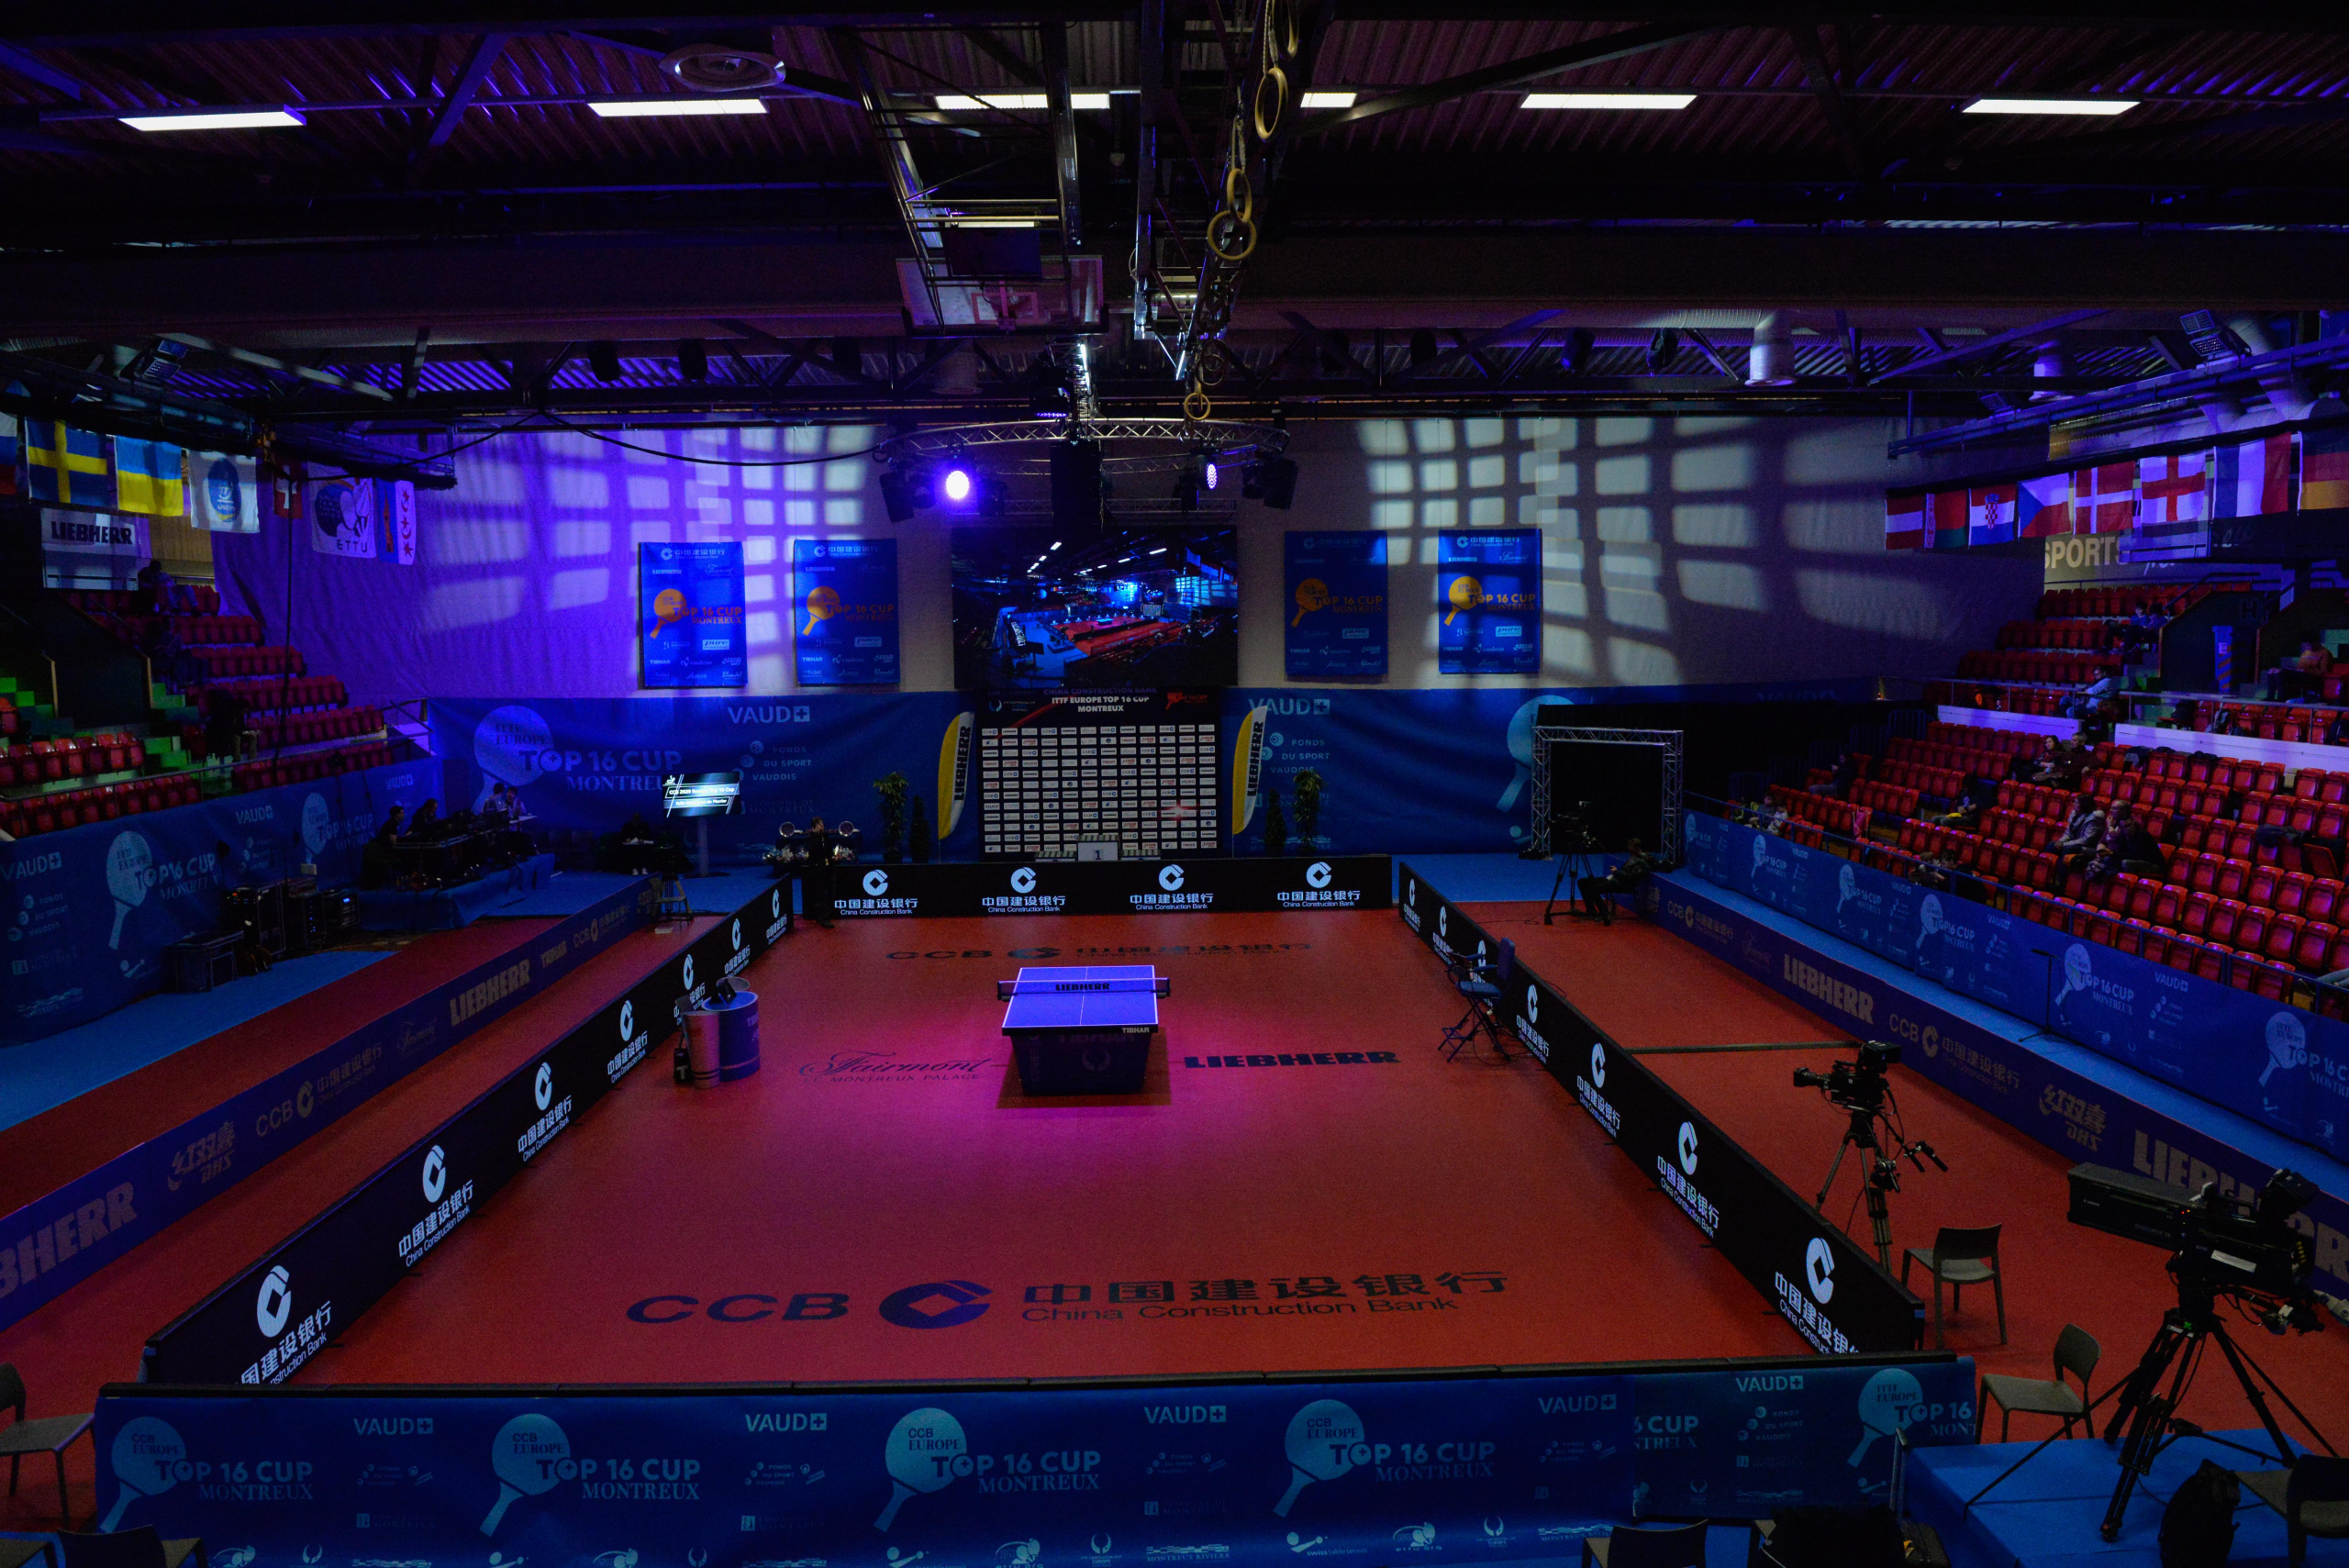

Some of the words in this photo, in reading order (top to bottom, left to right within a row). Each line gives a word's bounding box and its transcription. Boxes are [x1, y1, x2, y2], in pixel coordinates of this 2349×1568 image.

[50, 520, 133, 545] LIEBHERR
[337, 539, 368, 553] ETTU
[870, 604, 895, 614] CUP
[1357, 595, 1383, 606] CUP
[1467, 595, 1493, 605] TOP
[1497, 595, 1508, 604] 16
[1511, 594, 1536, 604] CUP
[1486, 603, 1535, 612] MONTREUX
[673, 607, 698, 617] TOP
[702, 607, 714, 617] 16
[717, 606, 742, 617] CUP
[1332, 606, 1382, 614] MONTREUX
[728, 706, 791, 723] VAUD
[1248, 697, 1311, 716] VAUD
[495, 734, 549, 745] EUROPE
[518, 749, 583, 772] TOP
[588, 751, 618, 772] 16
[622, 750, 683, 772] CUP
[781, 759, 812, 767] SPORT
[954, 726, 972, 800] LIEBHERR
[1247, 721, 1264, 796] LIEBHERR
[752, 773, 796, 781] VAUDOIS
[236, 806, 267, 825] VAUD
[1094, 850, 1101, 861] 1
[0, 855, 49, 881] VAUD
[135, 863, 169, 891] TOP
[170, 861, 184, 882] 16
[186, 852, 217, 877] CUP
[834, 898, 918, 910] 中国建设银行
[982, 895, 1066, 907] 中国建设银行
[1130, 893, 1214, 905] 中国建设银行
[1277, 890, 1361, 902] 中国建设银行
[1868, 892, 1882, 906] CUP
[1667, 900, 1684, 919] CCB
[1956, 925, 1976, 941] CUP
[724, 944, 751, 974] 中国建设银行
[885, 950, 993, 960] CCB
[1055, 983, 1110, 991] LIEBHERR
[1783, 952, 1874, 1025] LIEBHERR
[2080, 971, 2100, 988] TOP
[2100, 979, 2111, 995] 16
[2111, 984, 2134, 1002] CUP
[2154, 971, 2180, 989] VAUD
[449, 959, 530, 1028] LIEBHERR
[2092, 991, 2133, 1016] MONTREUX
[1516, 1014, 1550, 1058] 中国建设银行
[1889, 1013, 1920, 1043] CCB
[607, 1030, 648, 1075] 中国建设银行
[1184, 1051, 1402, 1068] LIEBHERR
[2288, 1044, 2321, 1068] TOP
[2323, 1057, 2335, 1076] 16
[799, 1051, 991, 1076] Fairmont
[1943, 1036, 2021, 1090] 中国建设银行
[1576, 1074, 1620, 1130] 中国建设银行
[2042, 1083, 2108, 1135] 红双喜
[256, 1099, 294, 1138] CCB
[518, 1095, 572, 1153] 中国建设银行
[523, 1146, 536, 1162] China
[536, 1126, 560, 1151] Construction
[559, 1117, 570, 1130] Bank
[2065, 1119, 2103, 1152] DHS
[171, 1120, 236, 1175] 红双喜
[200, 1150, 235, 1184] DHS
[1657, 1155, 1720, 1230] 中国建设银行
[1661, 1177, 1674, 1195] China
[1674, 1190, 1701, 1228] Construction
[1701, 1218, 1714, 1239] Bank
[398, 1179, 473, 1258] 中国建设银行
[406, 1247, 423, 1267] China
[424, 1216, 457, 1251] Construction
[456, 1205, 471, 1223] Bank
[1024, 1271, 1509, 1305] 中国建设银行
[626, 1293, 850, 1323] CCB
[1022, 1307, 1123, 1323] China
[1139, 1299, 1356, 1320] Construction
[1367, 1296, 1458, 1312] Bank
[1775, 1271, 1859, 1354] 中国建设银
[1780, 1299, 1798, 1325] China
[236, 1300, 332, 1384] 国建设银行
[306, 1332, 328, 1357] Bank
[1735, 1376, 1788, 1392] VAUD
[1539, 1395, 1598, 1415] VAUD
[1876, 1392, 1917, 1403] EUROPE
[1144, 1405, 1208, 1425] VAUD
[1894, 1403, 1944, 1423] TOP
[1949, 1401, 1972, 1420] 16
[353, 1418, 414, 1436] VAUD
[745, 1413, 807, 1432] VAUD
[1307, 1418, 1332, 1429] CCB
[1647, 1415, 1698, 1434] CUP
[1779, 1420, 1803, 1429] SPORT
[512, 1432, 538, 1442] CCB
[908, 1428, 934, 1439] CCB
[1307, 1428, 1358, 1440] EUROPE
[1755, 1432, 1791, 1440] VAUDOIS
[132, 1444, 182, 1455] EUROPE
[513, 1443, 564, 1454] EUROPE
[908, 1439, 962, 1451] EUROPE
[1330, 1442, 1392, 1465] TOP
[1400, 1442, 1429, 1464] 16
[1436, 1441, 1496, 1463] CUP
[154, 1460, 212, 1482] TOP
[219, 1462, 249, 1484] 16
[256, 1461, 314, 1483] CUP
[536, 1457, 598, 1482] TOP
[607, 1458, 634, 1482] 16
[642, 1458, 701, 1482] CUP
[931, 1454, 995, 1479] TOP
[1004, 1454, 1032, 1475] 16
[1040, 1450, 1101, 1473] CUP
[1375, 1462, 1494, 1483] MONTREUX
[199, 1483, 314, 1501] MONTREUX
[582, 1482, 701, 1500] MONTREUX
[978, 1473, 1100, 1495] MONTREUX
[1147, 1553, 1194, 1562] MONTREUX
[1196, 1551, 1230, 1561] RIVIERA
